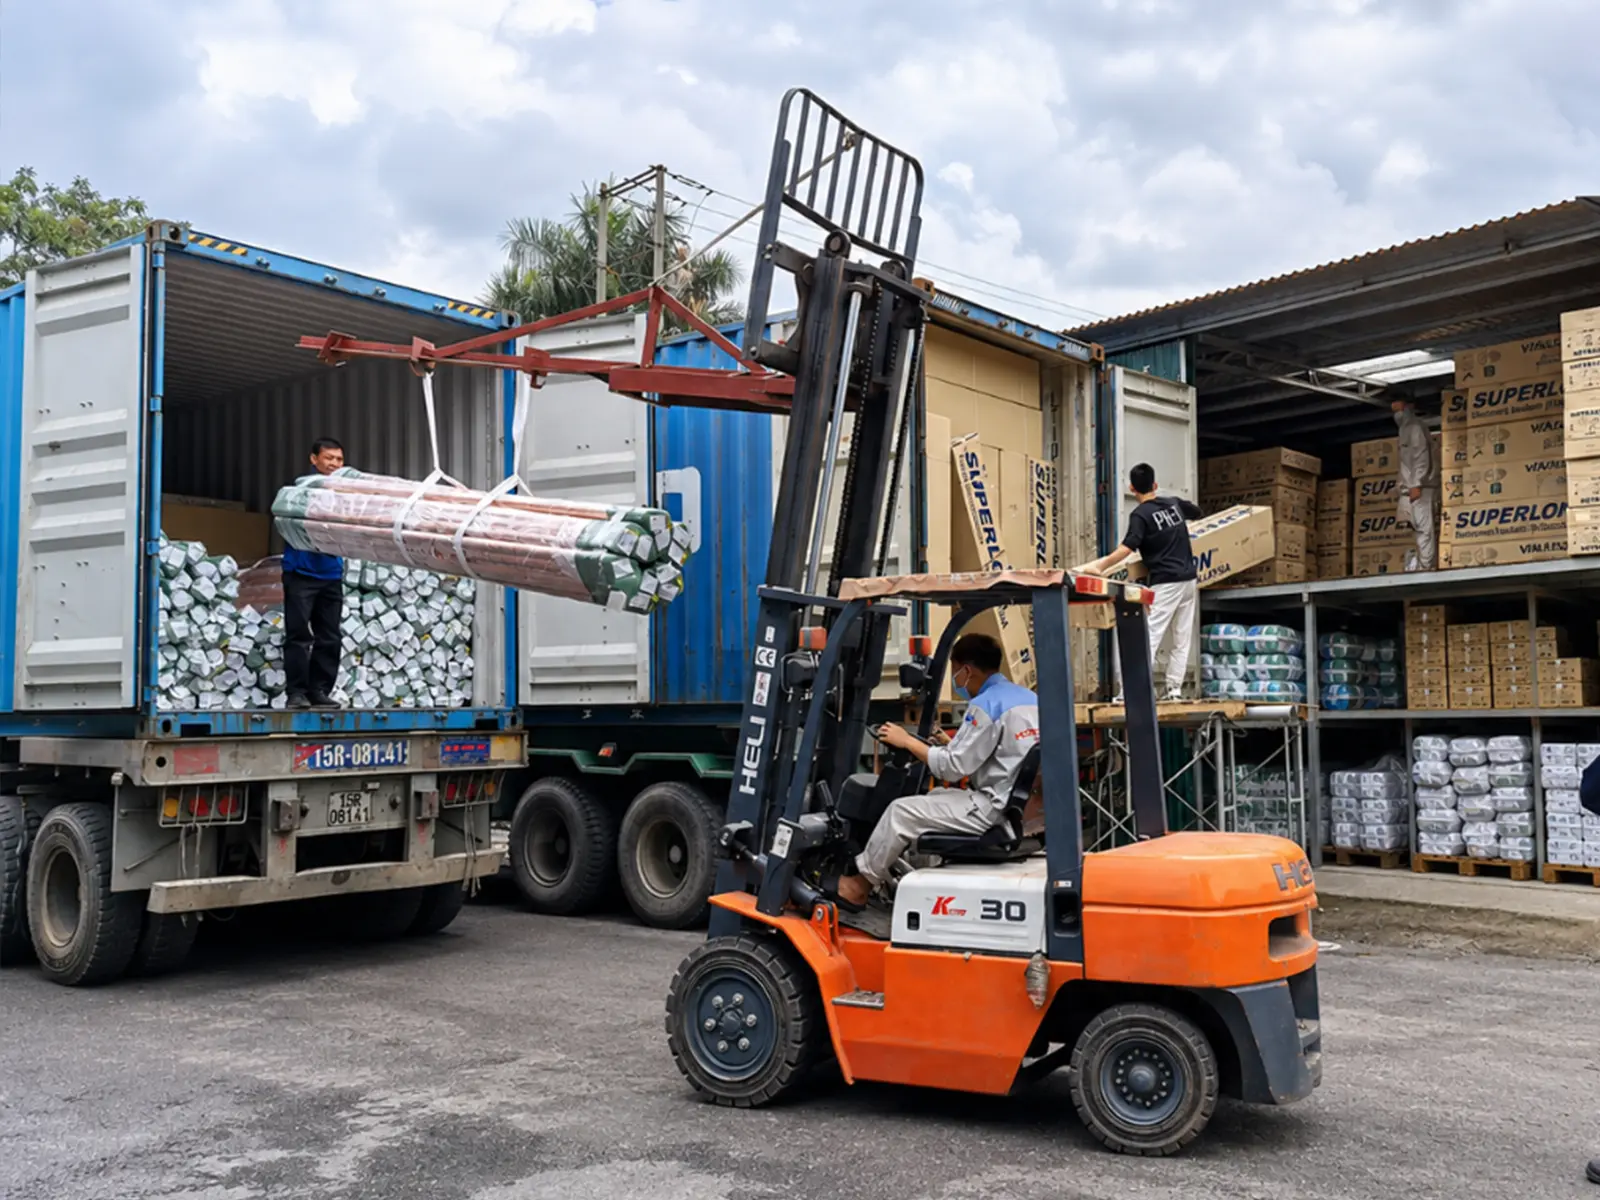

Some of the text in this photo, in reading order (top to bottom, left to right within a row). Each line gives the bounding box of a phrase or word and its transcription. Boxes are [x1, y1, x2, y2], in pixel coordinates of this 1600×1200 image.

[739, 716, 767, 796] HELI
[339, 793, 362, 809] 15R
[329, 807, 369, 825] 08141
[980, 899, 1026, 922] 30
